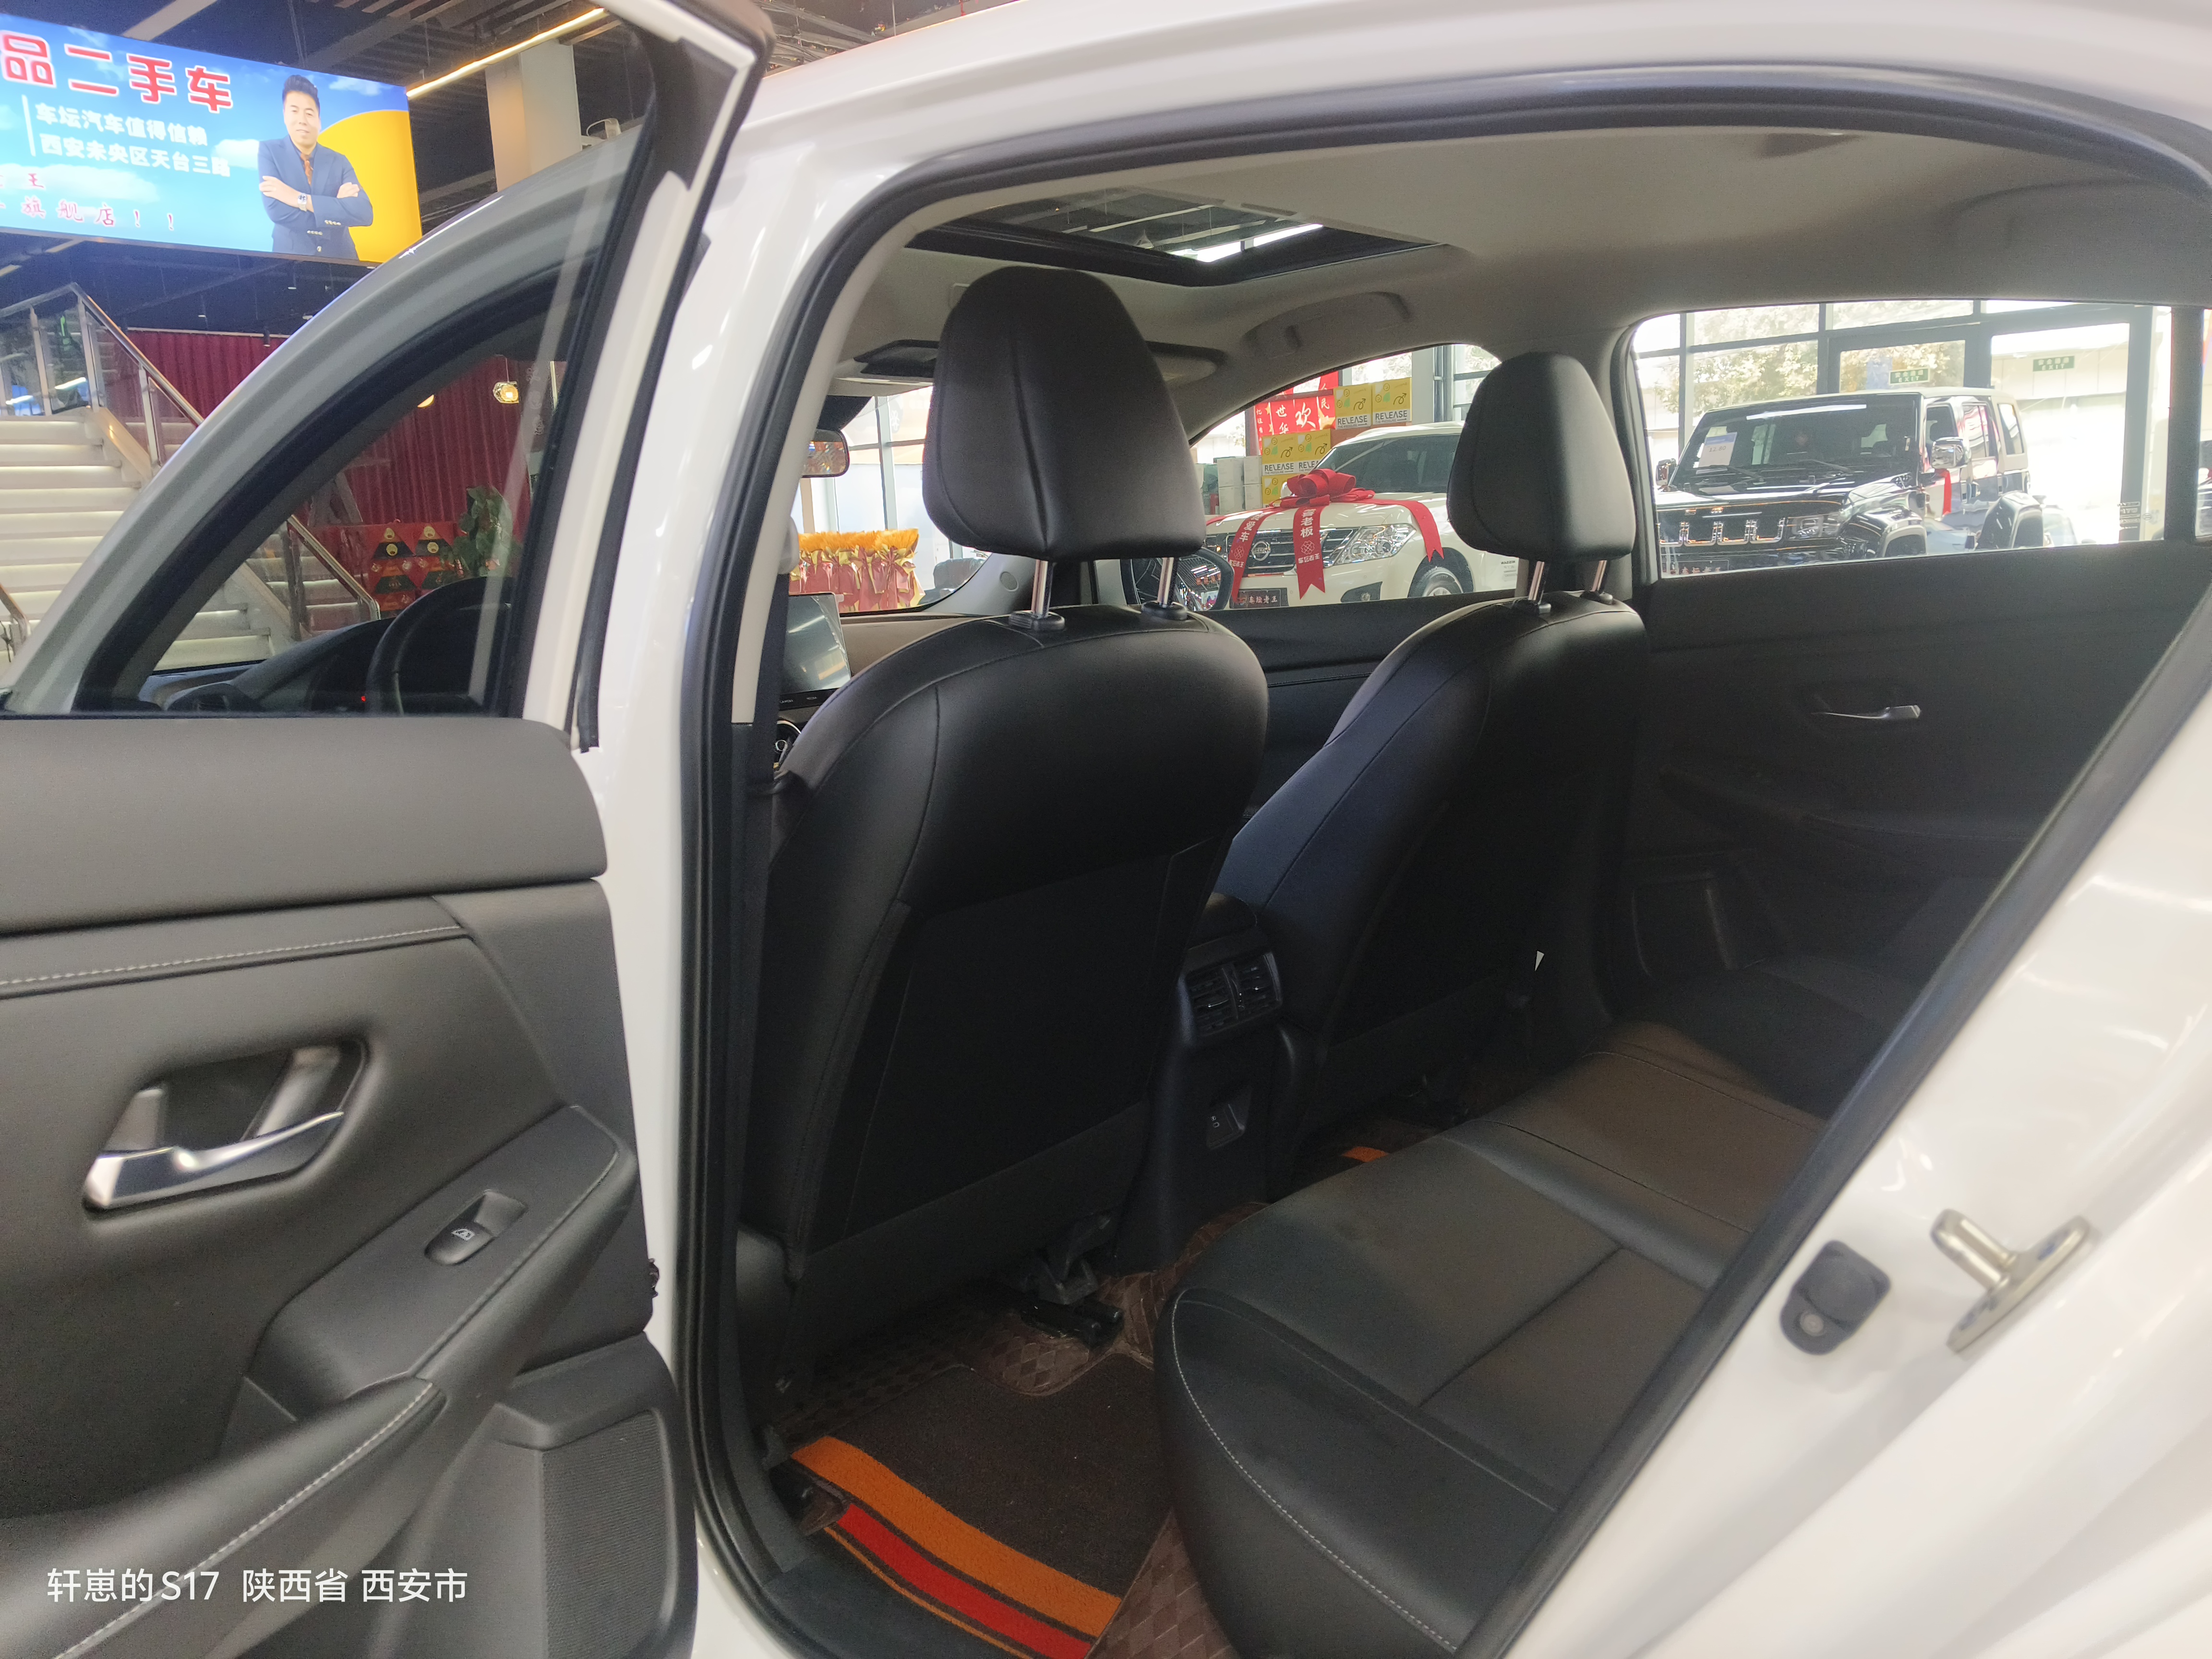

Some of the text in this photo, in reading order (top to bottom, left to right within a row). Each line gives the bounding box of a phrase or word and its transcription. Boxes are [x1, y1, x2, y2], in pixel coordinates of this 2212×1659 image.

[1, 31, 233, 113] 品二手车
[35, 102, 208, 146] 车坛汽车值得信赖
[39, 132, 230, 177] 西安未央区天台三路
[0, 196, 174, 230] 旗舰店！！
[1337, 415, 1368, 425] RELEASE
[1375, 410, 1407, 421] RELEASE
[1264, 463, 1294, 471] RELEASE
[1298, 460, 1319, 469] RELE
